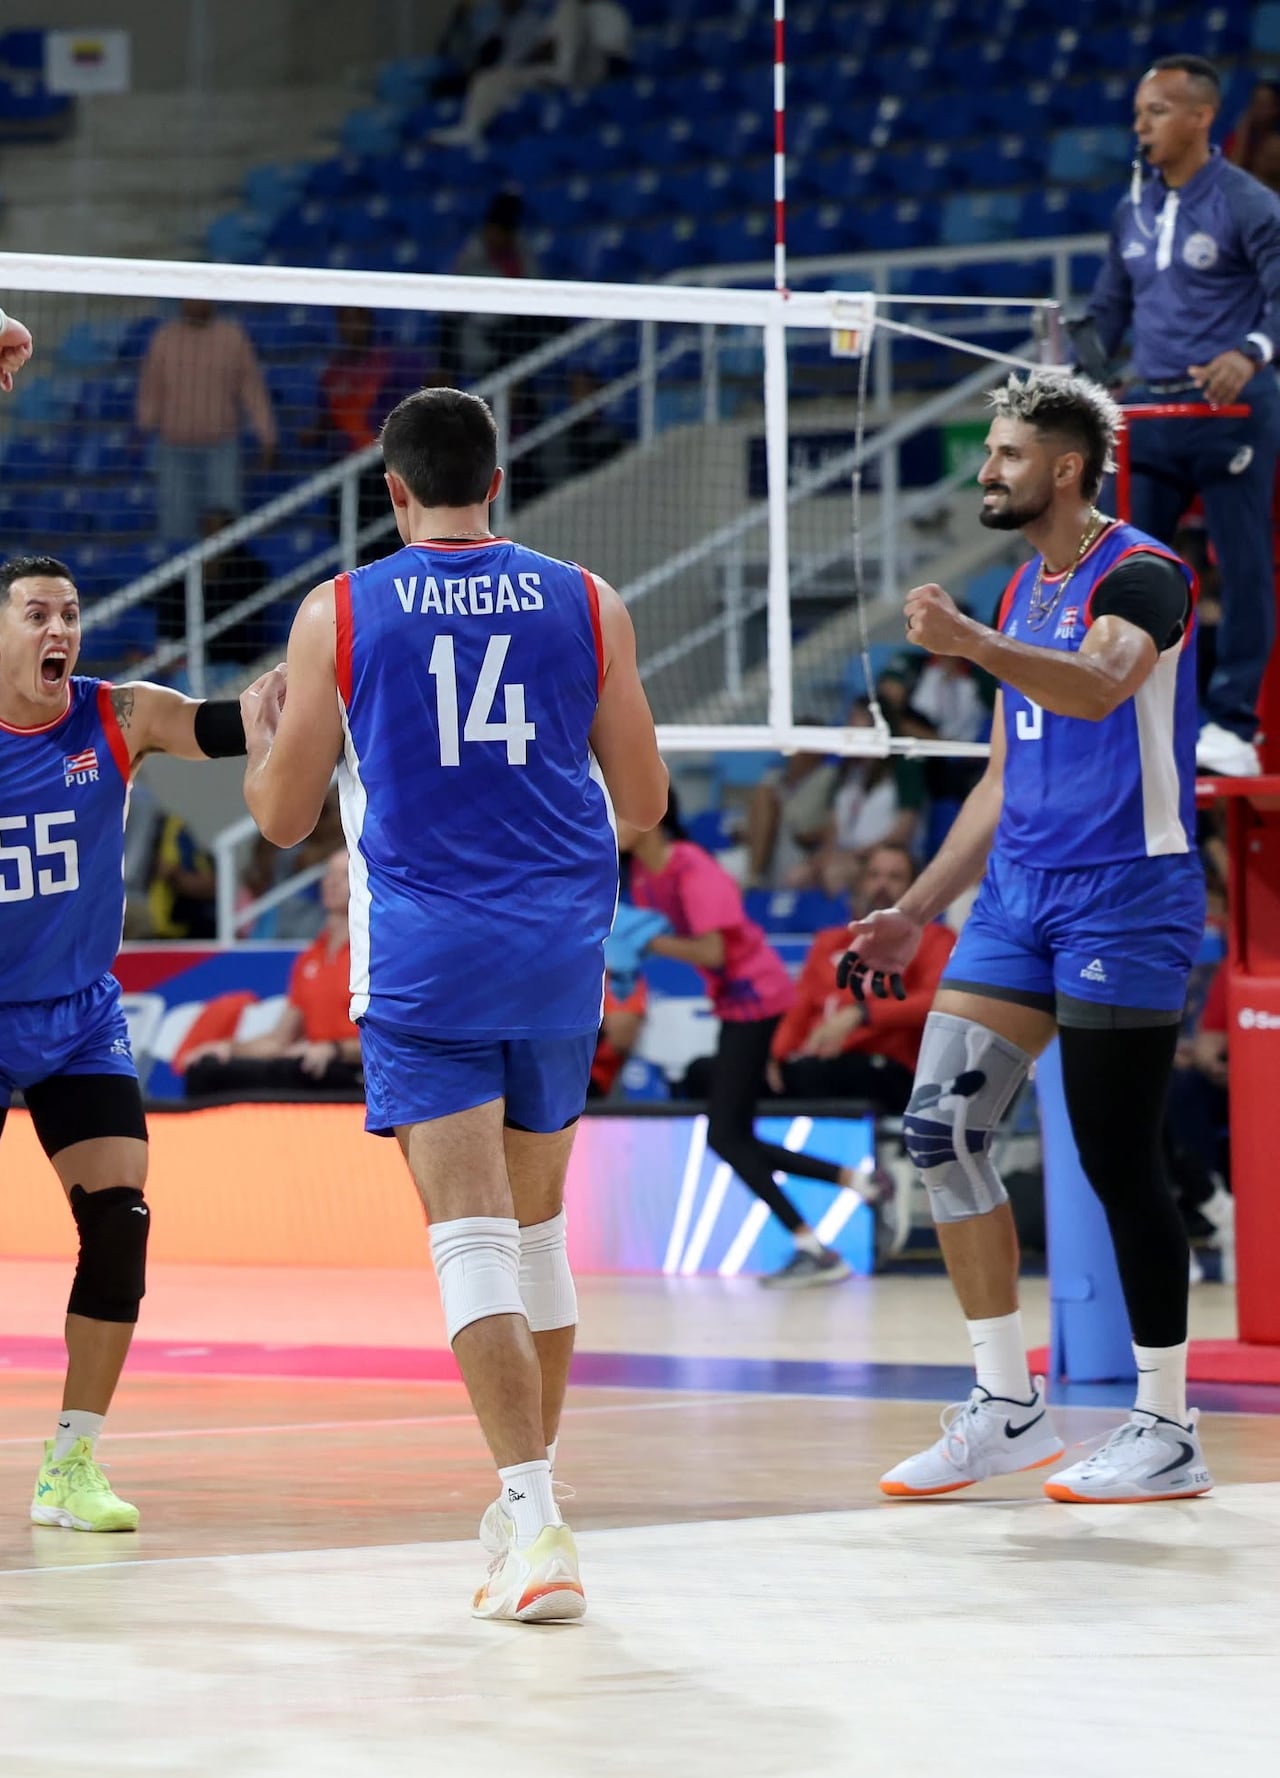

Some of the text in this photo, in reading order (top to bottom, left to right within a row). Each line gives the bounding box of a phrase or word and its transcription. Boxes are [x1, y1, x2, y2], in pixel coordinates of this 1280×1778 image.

[393, 573, 543, 615] VARGAS
[428, 635, 536, 766] 14
[65, 770, 99, 787] PUR
